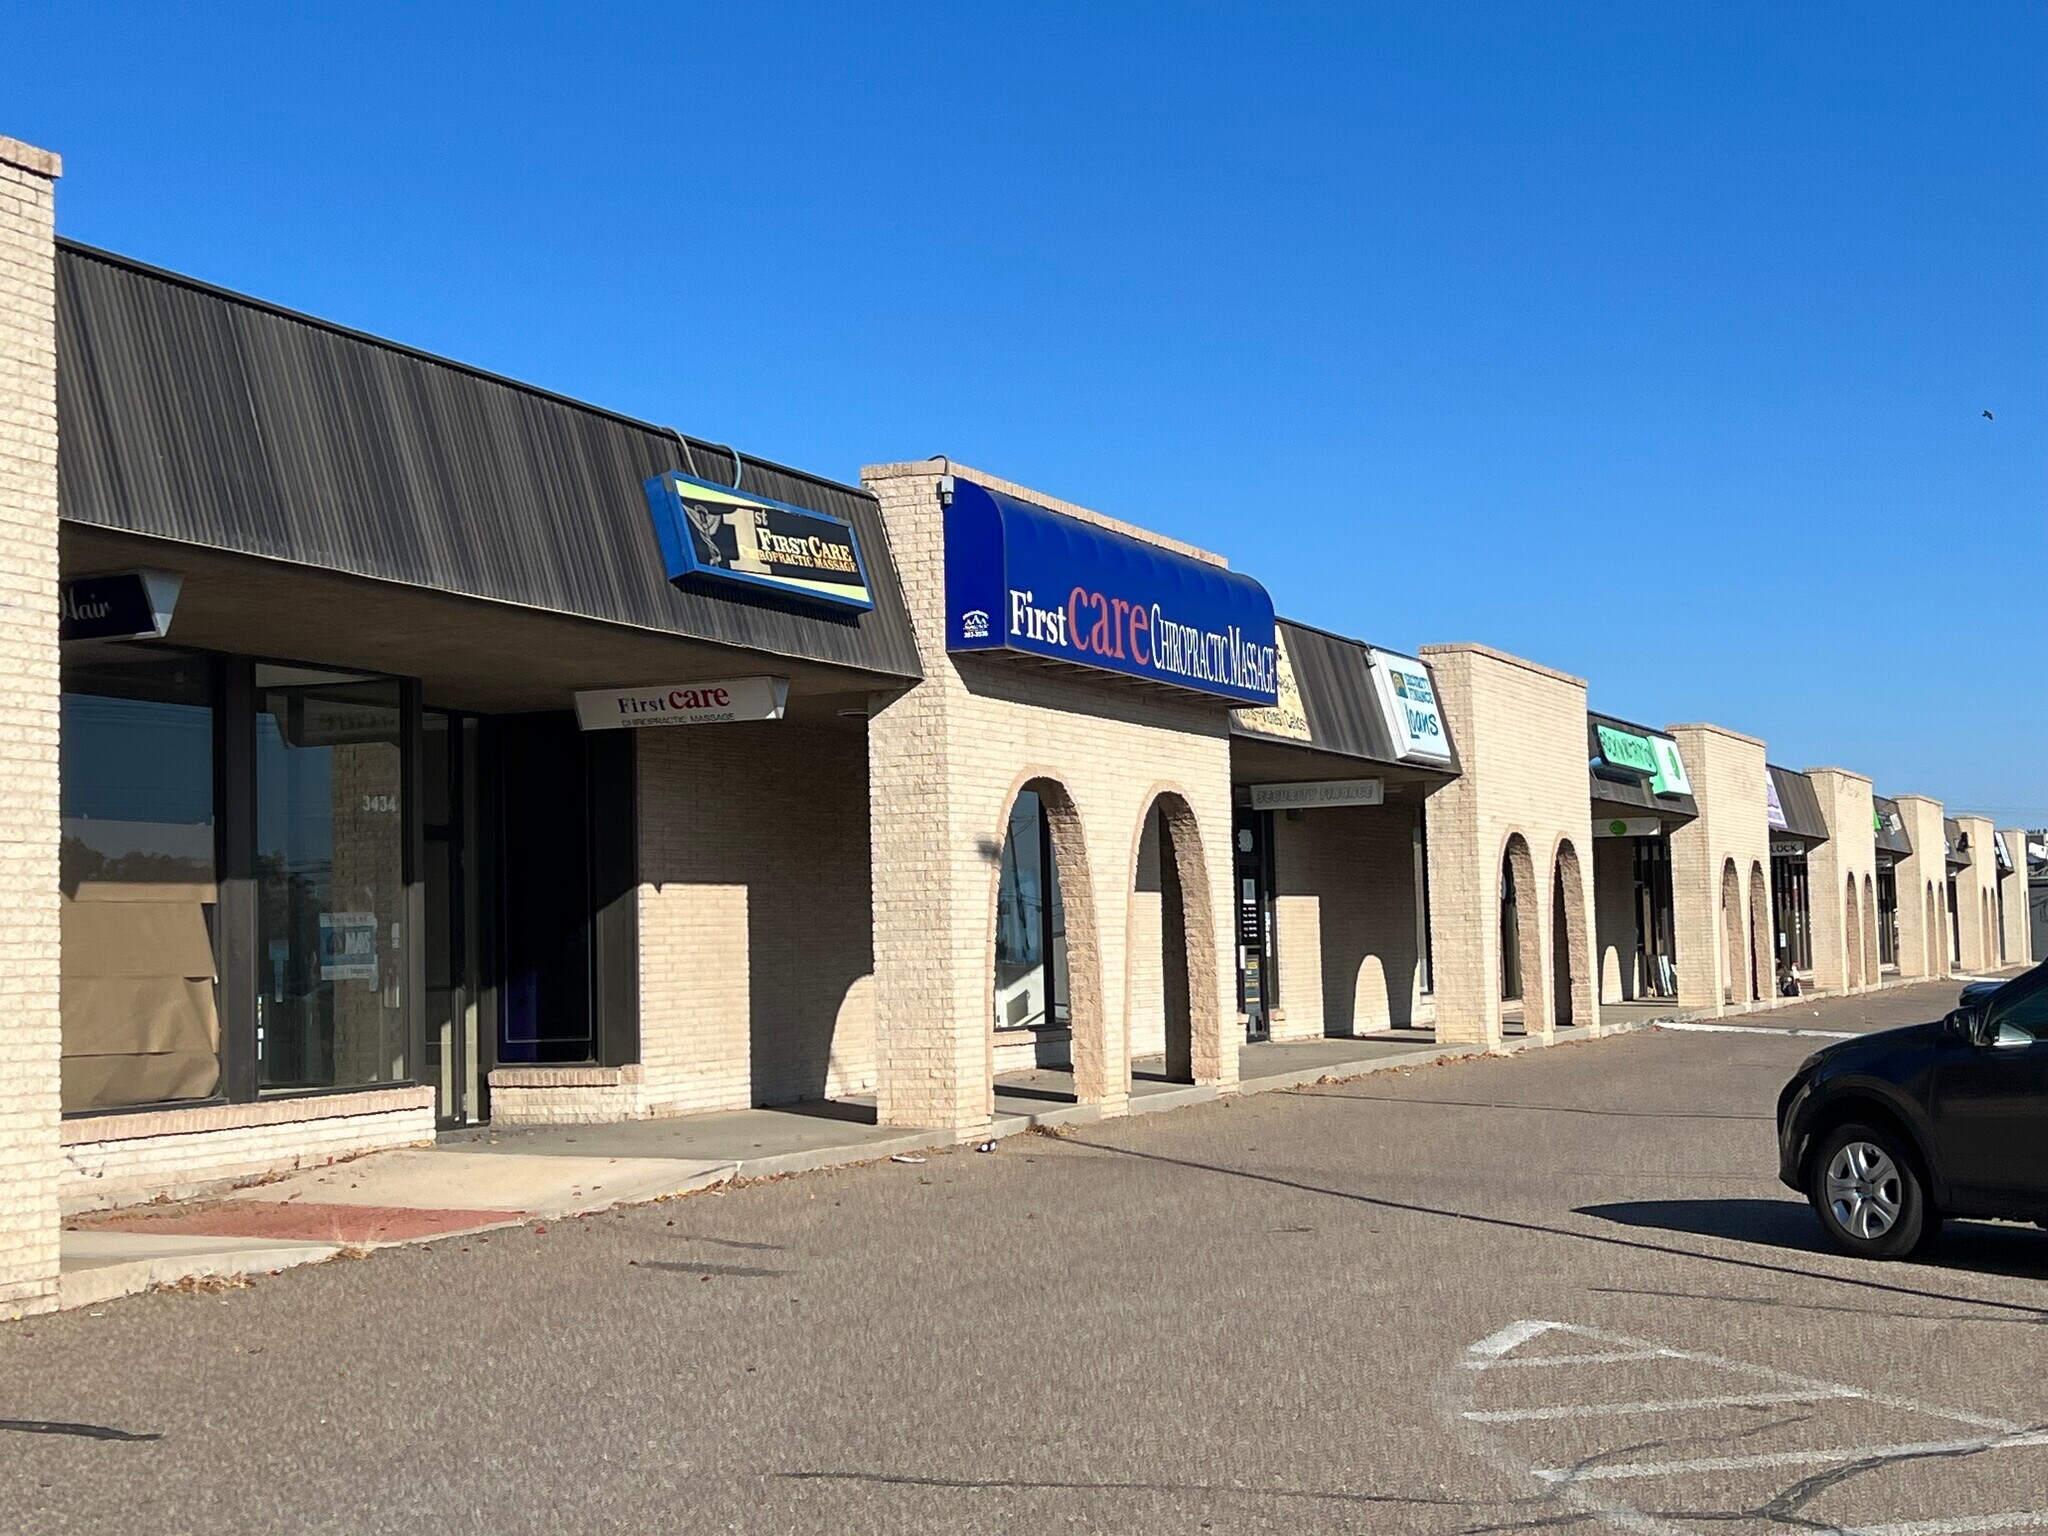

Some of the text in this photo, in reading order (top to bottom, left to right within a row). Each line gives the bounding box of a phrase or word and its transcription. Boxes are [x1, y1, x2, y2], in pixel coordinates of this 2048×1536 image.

[739, 544, 858, 573] CHIROPRACTIC MASSAGE
[1010, 586, 1276, 694] First care CHIROPRACTIC MASSAGE
[617, 687, 731, 714] First care
[621, 712, 735, 728] CHIROPRACTIC MASSAGE
[1404, 701, 1439, 740] Loans
[362, 795, 397, 812] 3434
